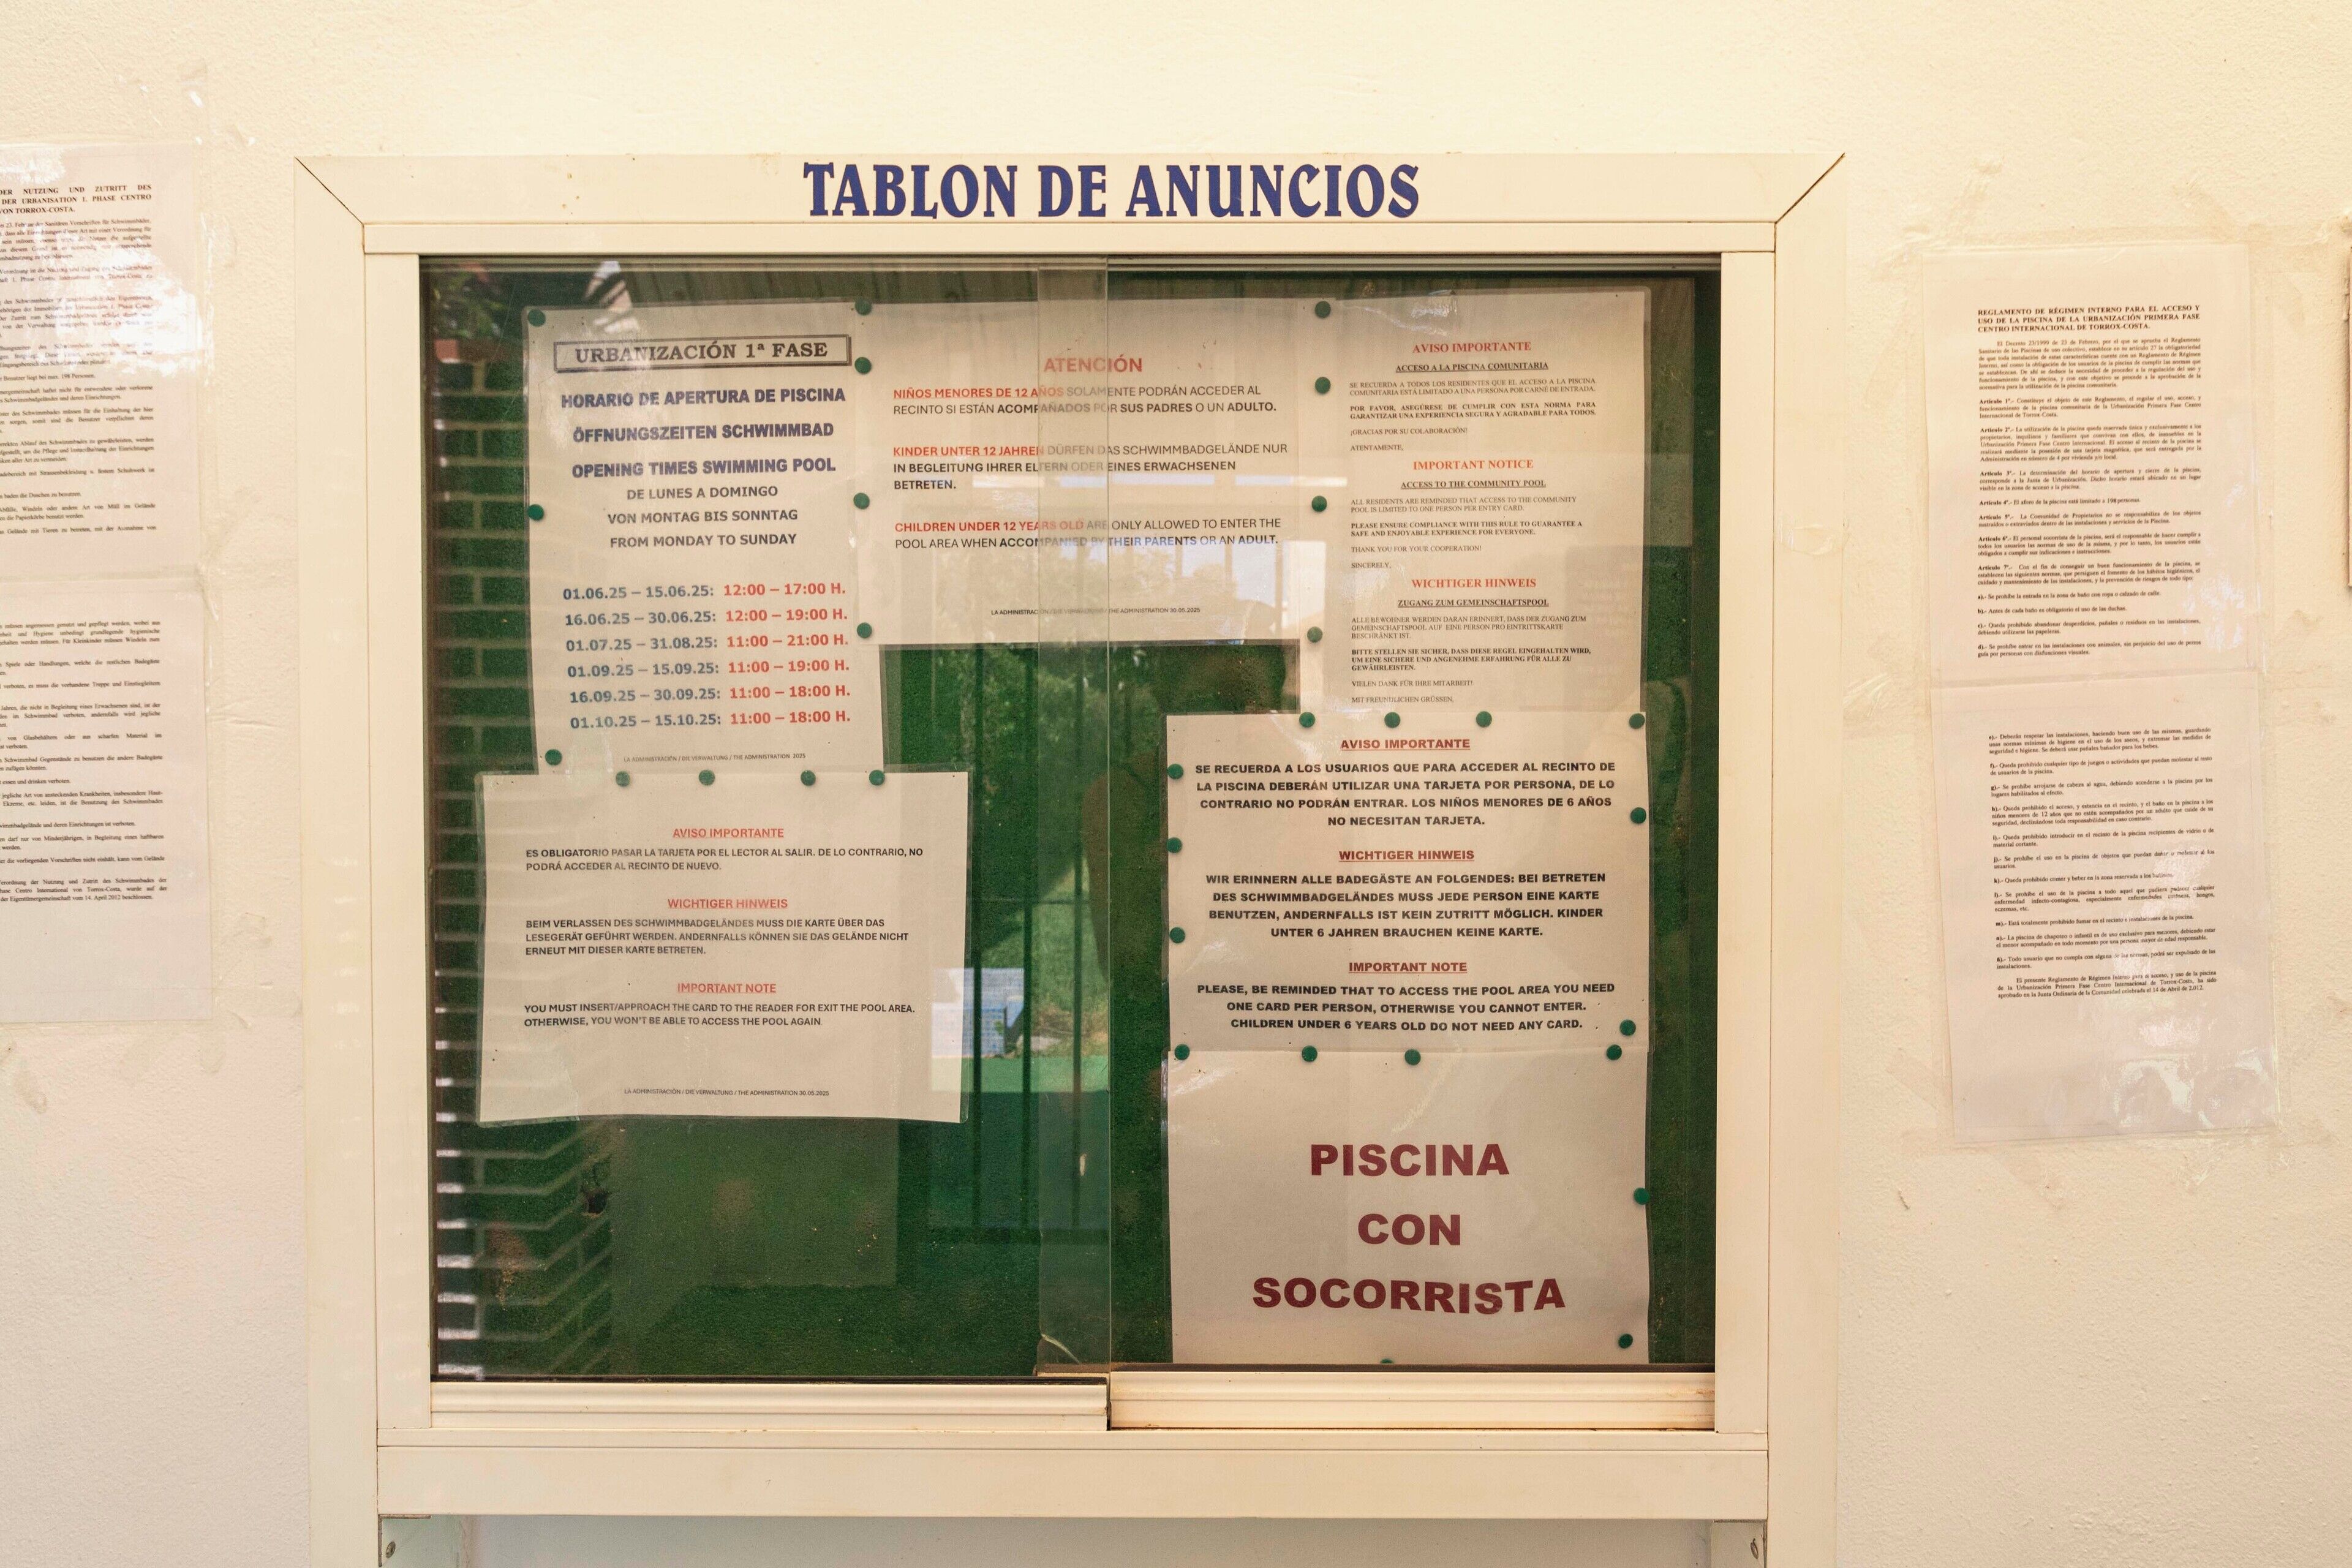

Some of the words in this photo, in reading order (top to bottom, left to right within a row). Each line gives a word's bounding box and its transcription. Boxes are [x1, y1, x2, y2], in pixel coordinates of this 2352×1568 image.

[803, 162, 1017, 219] TABLON
[1038, 164, 1106, 217] DE
[1125, 164, 1419, 217] ANUNCIOS
[575, 341, 736, 363] URBANIZACIÓN
[772, 342, 827, 358] FASE
[1413, 343, 1449, 353] AVISO
[1453, 341, 1531, 353] IMPORTANTE
[1044, 353, 1142, 372] ATENCIÓN
[1488, 362, 1549, 371] COMUNITARIA
[562, 392, 633, 409] HORARIO
[639, 391, 659, 406] DE
[664, 389, 750, 405] APERTURA
[755, 389, 775, 403] DE
[781, 388, 845, 402] PISCINA
[573, 424, 717, 443] ÖFFNUNGSZEITEN
[722, 423, 834, 439] SCHWIMMBAD
[572, 462, 643, 478] OPENING
[649, 461, 698, 475] TIMES
[703, 459, 787, 474] SWIMMING
[793, 458, 835, 472] POOL
[1414, 460, 1485, 470] IMPORTANT
[1488, 459, 1533, 469] NOTICE
[627, 489, 644, 500] DE
[649, 488, 692, 499] LUNES
[696, 487, 706, 498] A
[710, 486, 778, 498] DOMINGO
[608, 513, 636, 524] VON
[641, 511, 699, 524] MONTAG
[704, 510, 728, 522] BIS
[732, 510, 797, 521] SONNTAG
[895, 522, 955, 532] CHILDREN
[959, 521, 1000, 532] UNDER
[1003, 522, 1016, 531] 12
[1019, 521, 1056, 531] YEARS
[1060, 520, 1084, 530] OLD
[1112, 520, 1142, 530] ONLY
[1144, 519, 1199, 530] ALLOWED
[1202, 519, 1217, 529] TO
[1221, 518, 1256, 529] ENTER
[1259, 518, 1280, 527] THE
[611, 537, 648, 548] FROM
[654, 535, 713, 547] MONDAY
[717, 535, 736, 546] TO
[741, 533, 796, 545] SUNDAY
[1412, 579, 1482, 588] WICHTIGER
[1485, 578, 1536, 588] HINWEIS
[564, 587, 627, 600] 01.06.25
[646, 585, 714, 598] 15.06.25:
[724, 583, 765, 598] 12:00
[785, 582, 826, 595] 17:00
[831, 582, 845, 594] H.
[565, 612, 630, 625] 16.06.25
[649, 611, 715, 624] 30.06.25:
[726, 609, 767, 622] 12:00
[786, 608, 827, 621] 19:00
[833, 608, 847, 620] H.
[566, 638, 631, 652] 01.07.25
[650, 636, 717, 649] 31.08.25:
[727, 635, 768, 648] 11:00
[788, 634, 829, 647] 21:00
[834, 634, 848, 647] H.
[1341, 739, 1380, 749] AVISO
[1385, 739, 1470, 749] IMPORTANTE
[673, 828, 706, 839] AVISO
[710, 827, 783, 838] IMPORTANTE
[1339, 850, 1414, 861] WICHTIGER
[1418, 850, 1474, 860] HINWEIS
[668, 899, 733, 909] WICHTIGER
[736, 899, 788, 908] HINWEIS
[1349, 962, 1427, 972] IMPORTANT
[1431, 962, 1467, 972] NOTE
[678, 982, 742, 993] IMPORTANT
[746, 983, 776, 993] NOTE
[524, 1017, 588, 1027] OTHERWISE,
[663, 1016, 686, 1025] ABLE
[701, 1017, 739, 1025] ACCESS
[763, 1017, 788, 1026] POOL
[1231, 1019, 1293, 1028] CHILDREN
[1298, 1019, 1340, 1029] UNDER
[1344, 1020, 1351, 1029] 6
[1355, 1020, 1396, 1030] YEARS
[1401, 1022, 1426, 1031] OLD
[1430, 1022, 1447, 1031] DO
[1452, 1022, 1478, 1031] NOT
[1482, 1022, 1514, 1031] NEED
[1518, 1020, 1543, 1030] ANY
[1547, 1019, 1582, 1029] CARD.
[1311, 1144, 1509, 1177] PISCINA
[1358, 1213, 1460, 1246] CON
[1253, 1277, 1566, 1314] SOCORRISTA
